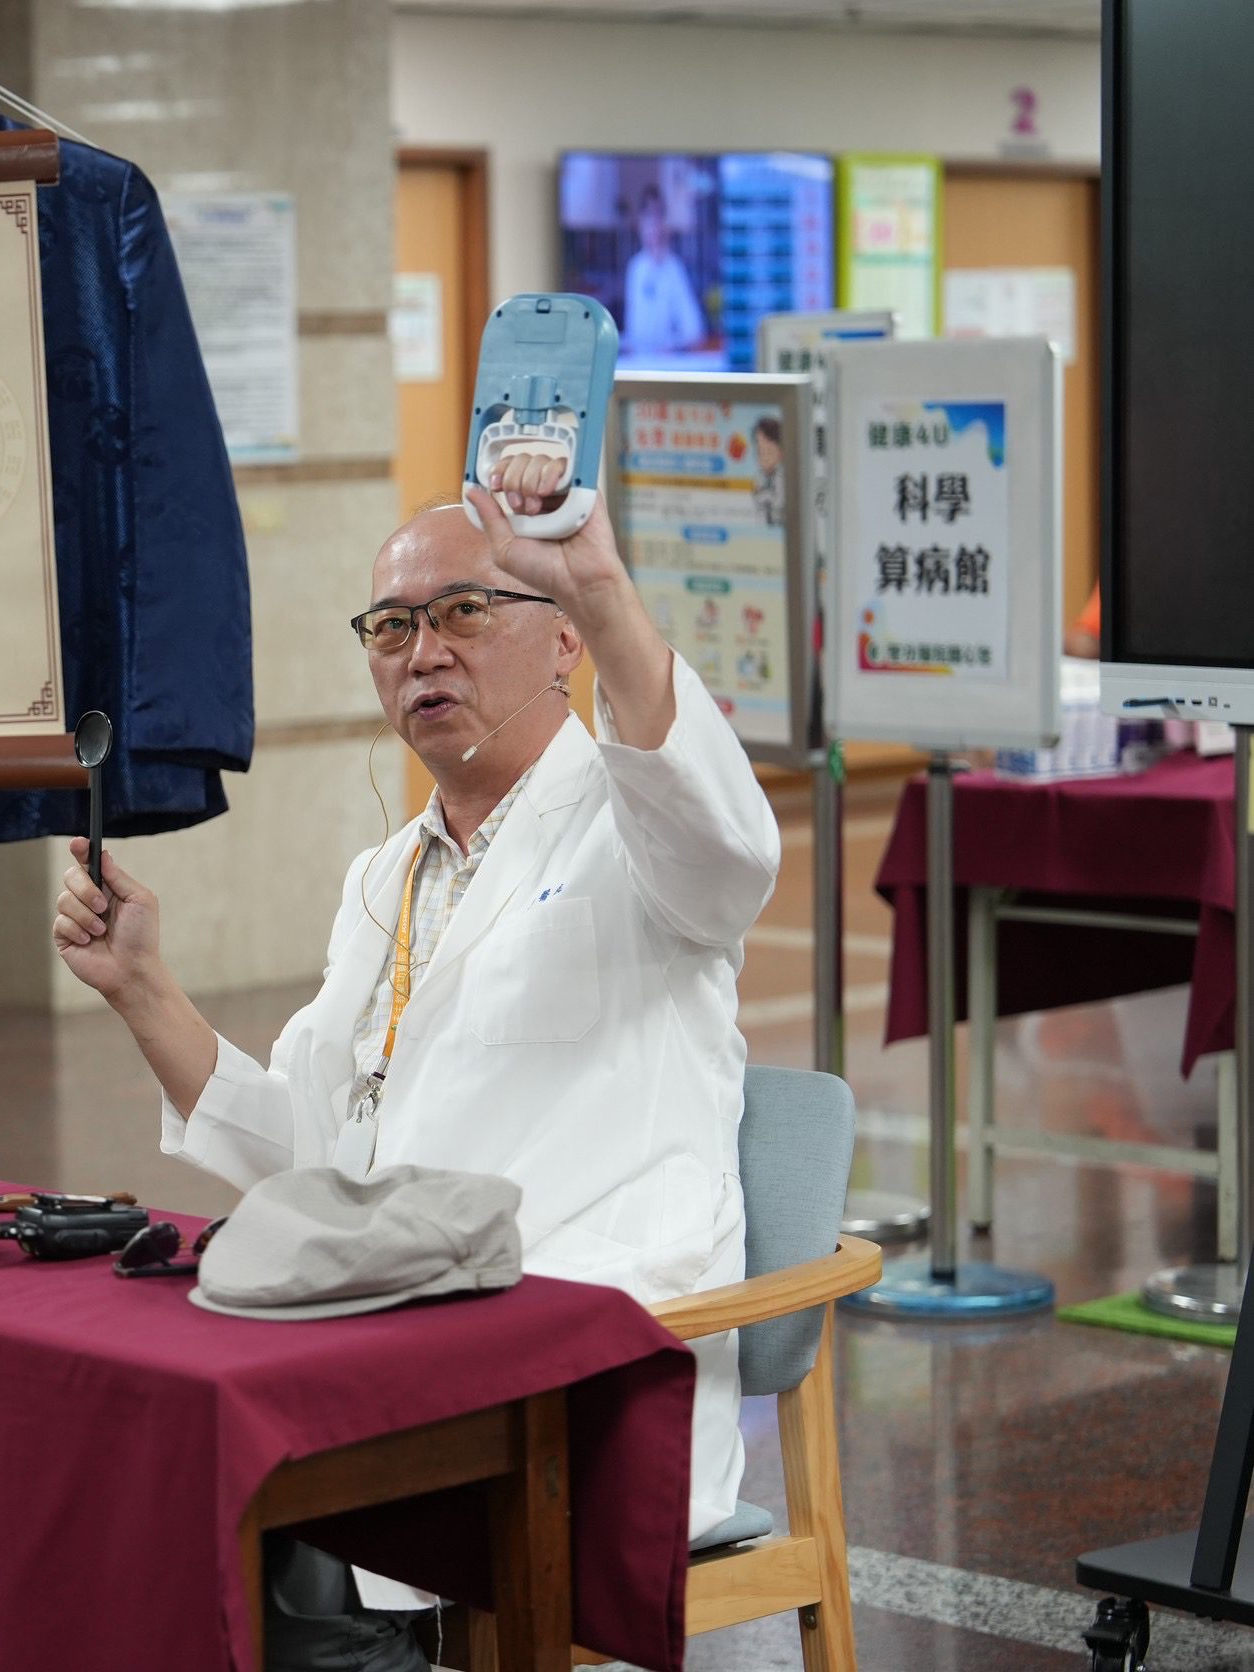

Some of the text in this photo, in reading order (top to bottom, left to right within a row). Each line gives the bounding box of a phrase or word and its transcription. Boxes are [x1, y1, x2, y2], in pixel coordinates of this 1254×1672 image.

[895, 472, 971, 525] 科學
[876, 542, 990, 596] 算病館
